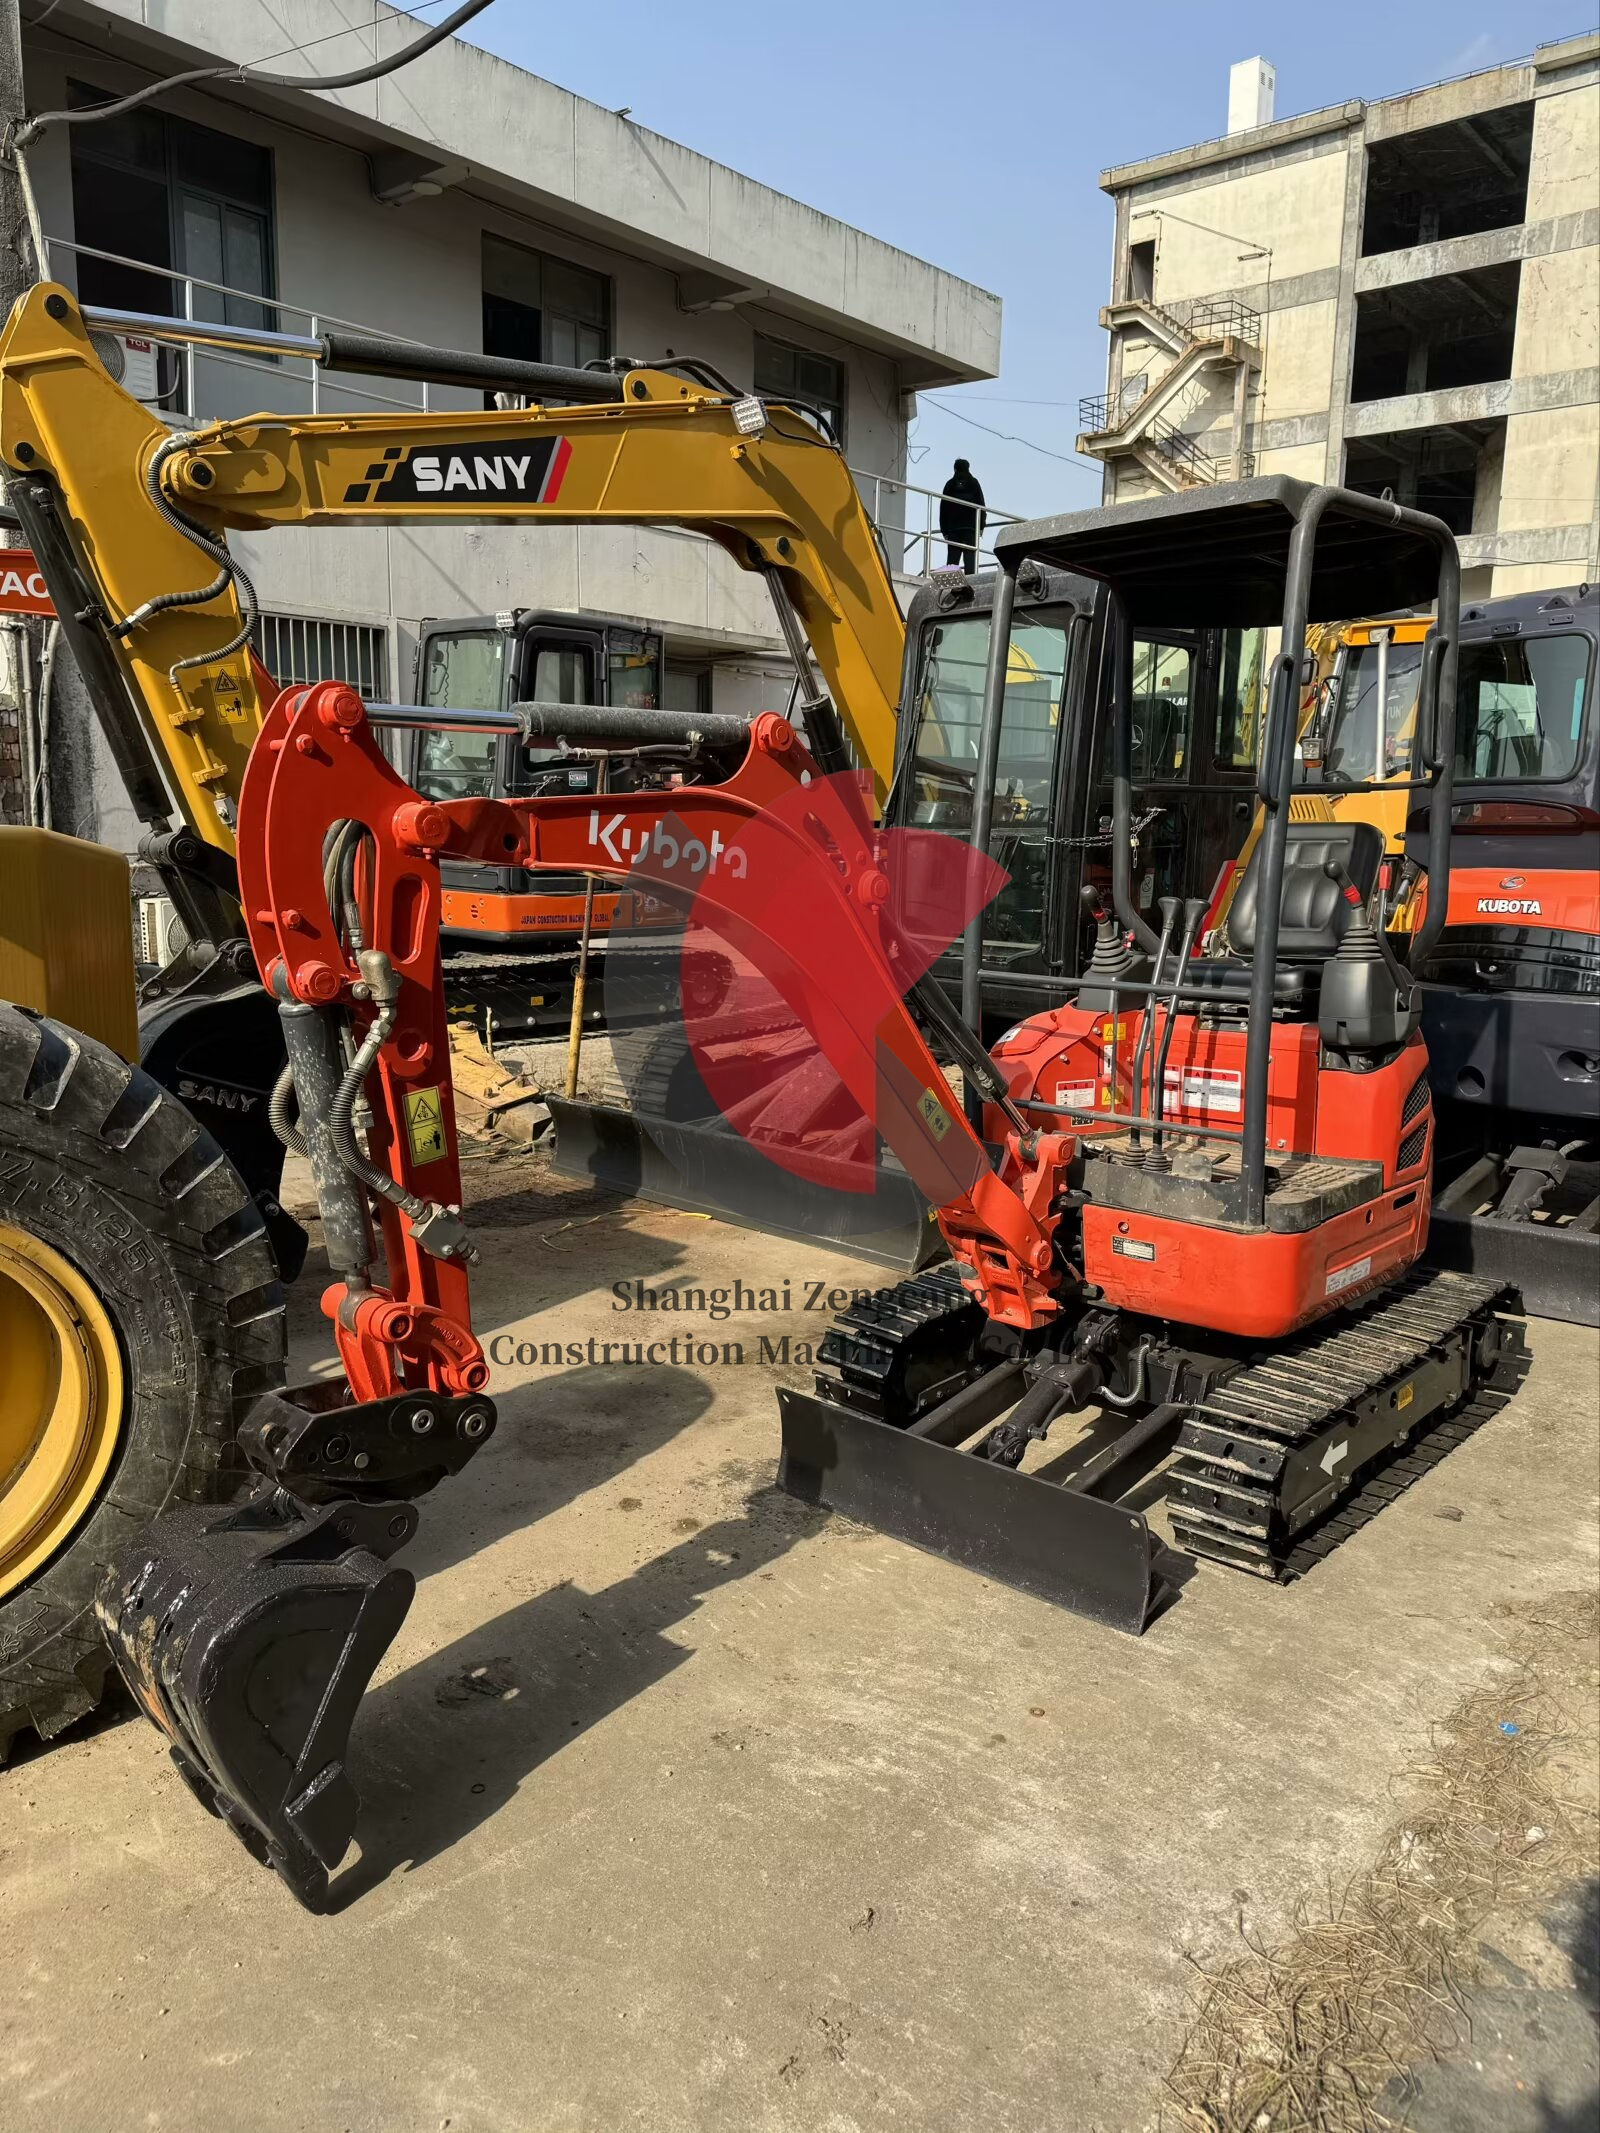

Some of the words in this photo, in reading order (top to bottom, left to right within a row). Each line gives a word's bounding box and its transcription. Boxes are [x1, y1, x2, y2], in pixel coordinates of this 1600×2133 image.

[129, 338, 148, 348] TCL
[412, 456, 531, 491] SANY
[588, 809, 748, 879] Kubota
[1477, 898, 1542, 915] KUBOTA
[178, 1080, 258, 1112] SANY
